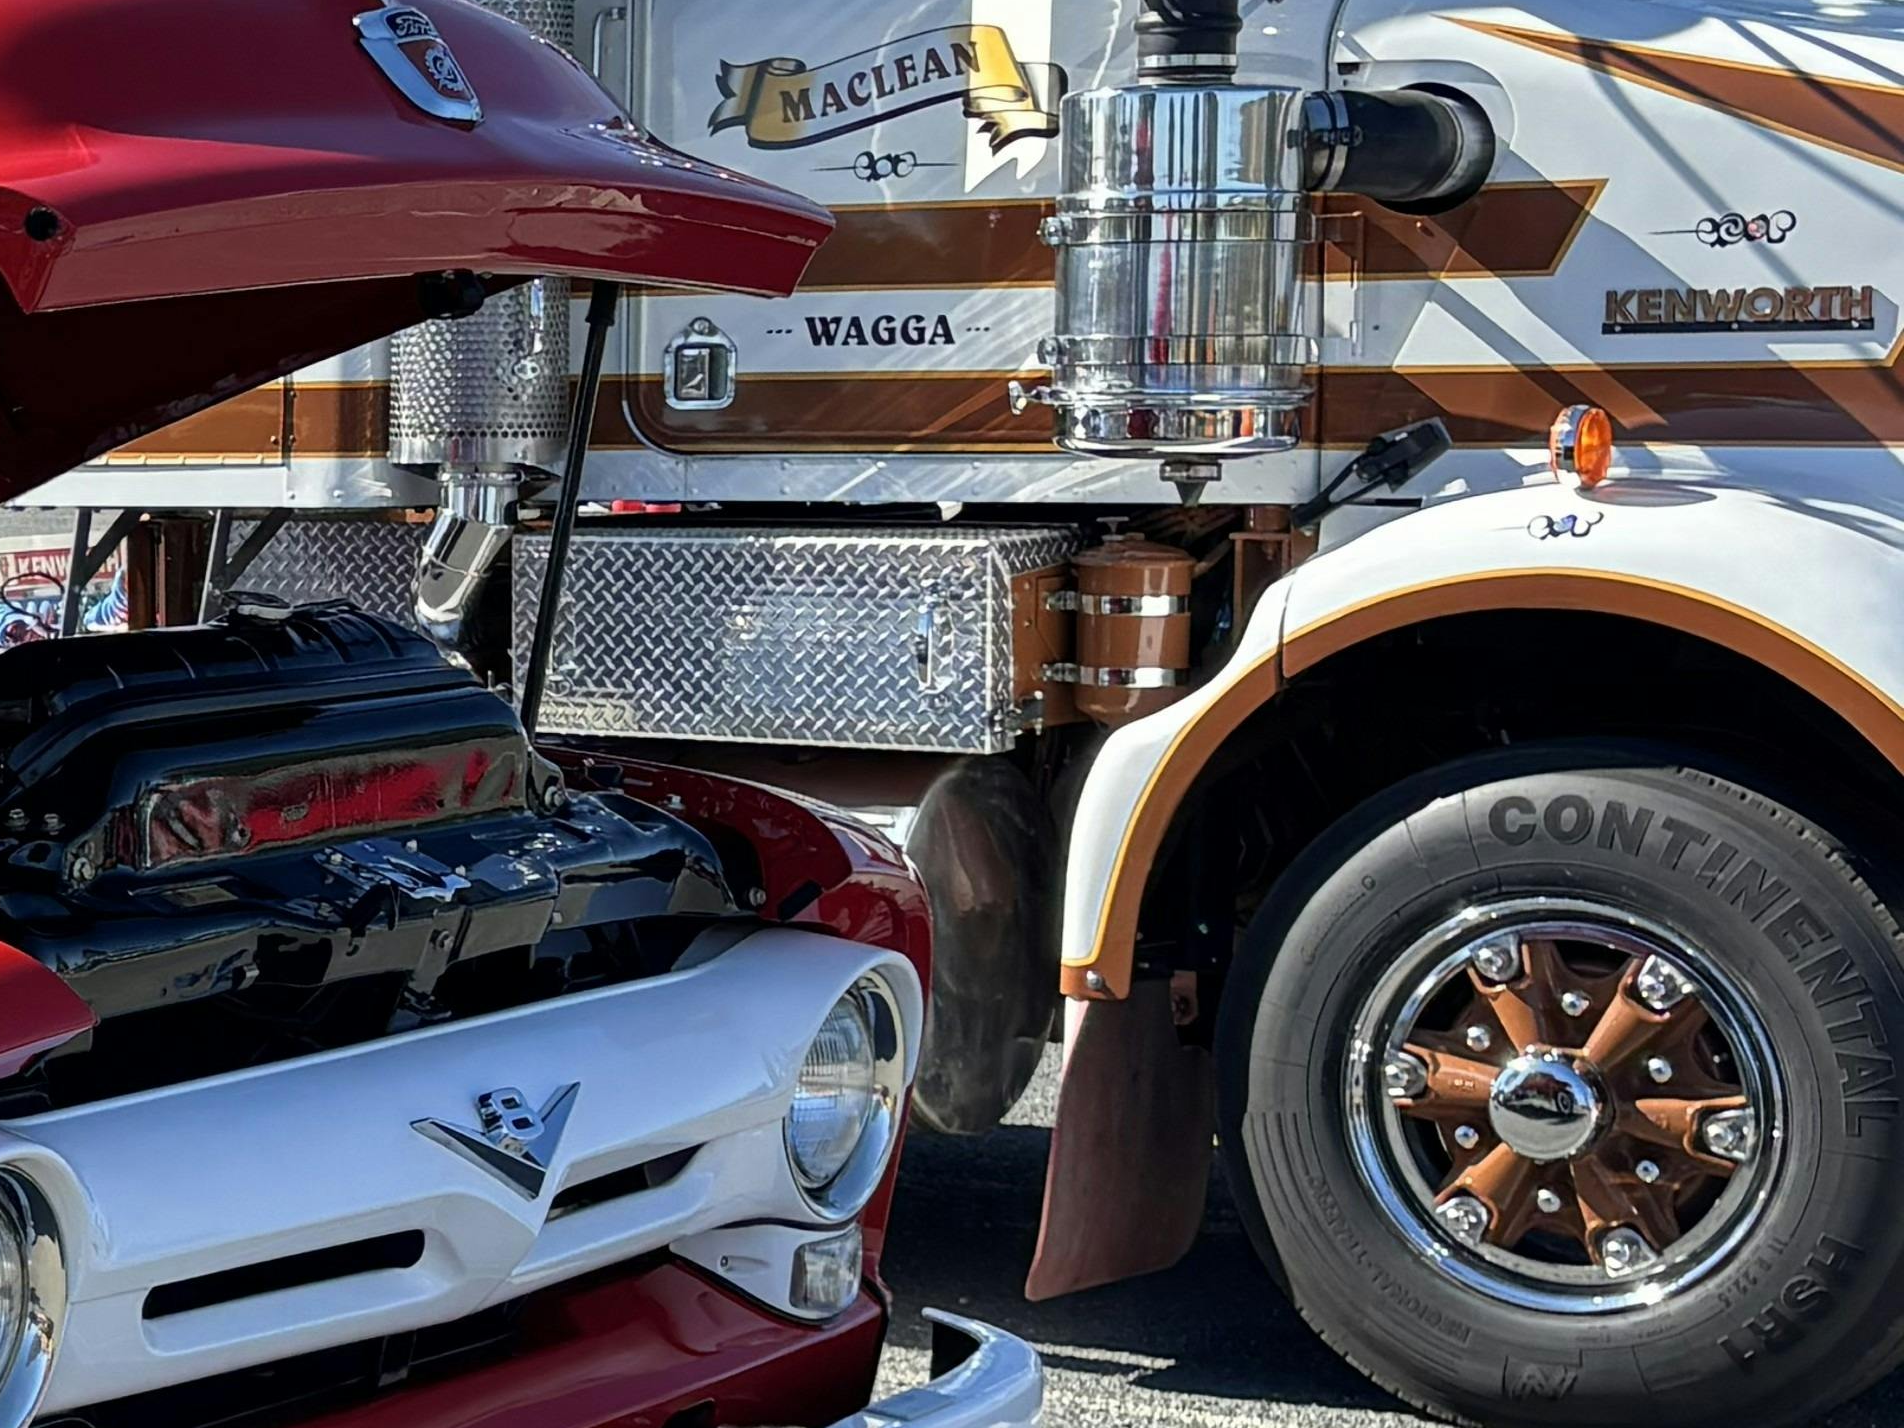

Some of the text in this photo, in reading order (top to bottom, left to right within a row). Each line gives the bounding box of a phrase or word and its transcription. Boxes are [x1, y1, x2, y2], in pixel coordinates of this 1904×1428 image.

[779, 41, 981, 123] MACLEAN
[1604, 275, 1876, 324] KENWORTH
[804, 314, 956, 346] WAGGA
[17, 547, 120, 580] KENWTH
[1488, 793, 1899, 1139] CONTINENTAL
